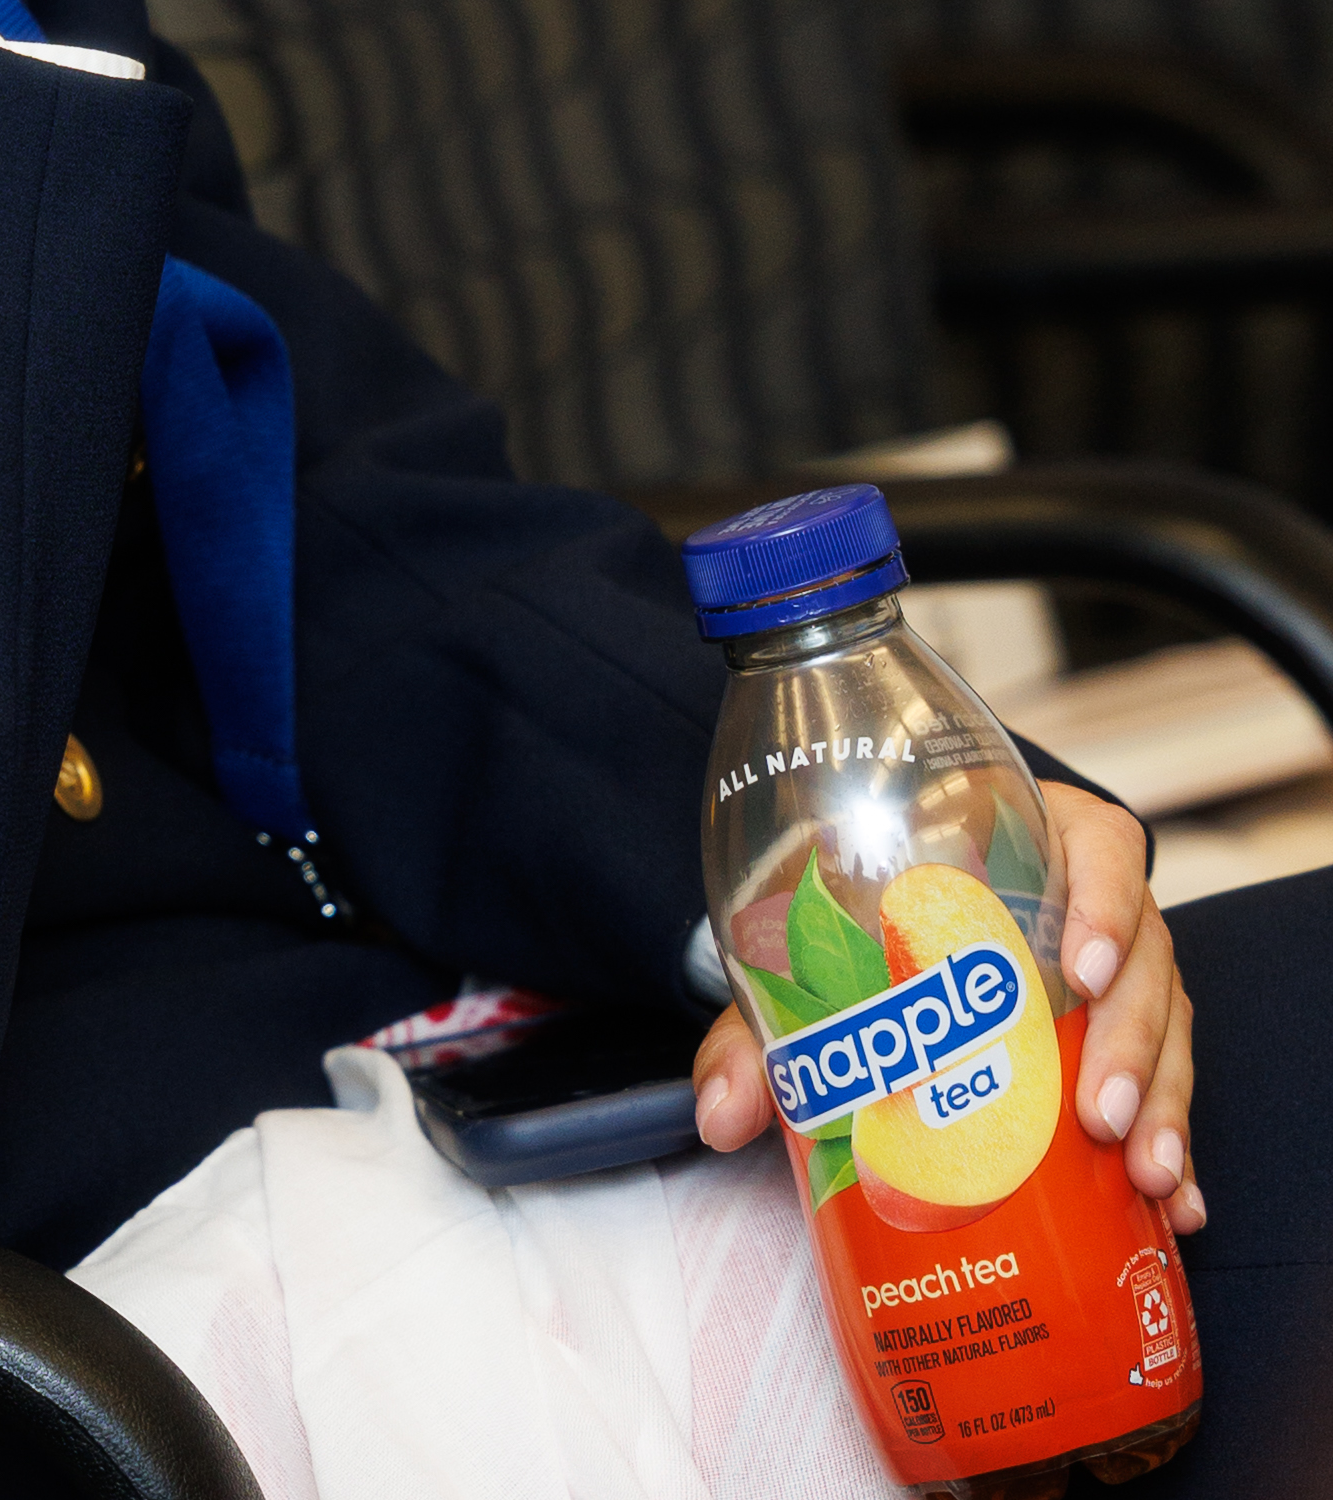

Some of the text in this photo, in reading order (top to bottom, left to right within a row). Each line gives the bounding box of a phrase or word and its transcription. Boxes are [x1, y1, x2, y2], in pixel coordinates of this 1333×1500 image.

[719, 736, 917, 803] ALL NATURAL
[773, 957, 1006, 1111] snapple
[930, 1064, 1000, 1119] tea
[861, 1251, 1020, 1318] peach tea
[873, 1298, 1033, 1353] NATURALLY FLAVORED
[874, 1323, 1050, 1378] WITH OTHER NATURAL FLAVORS
[1146, 1336, 1174, 1355] PLASTIC
[1145, 1376, 1163, 1390] help
[1148, 1348, 1175, 1367] BOTTLE
[897, 1387, 931, 1415] 150
[957, 1420, 972, 1439] 16
[973, 1416, 989, 1437] FL
[990, 1412, 1007, 1432] OZ
[1009, 1403, 1034, 1428] (473
